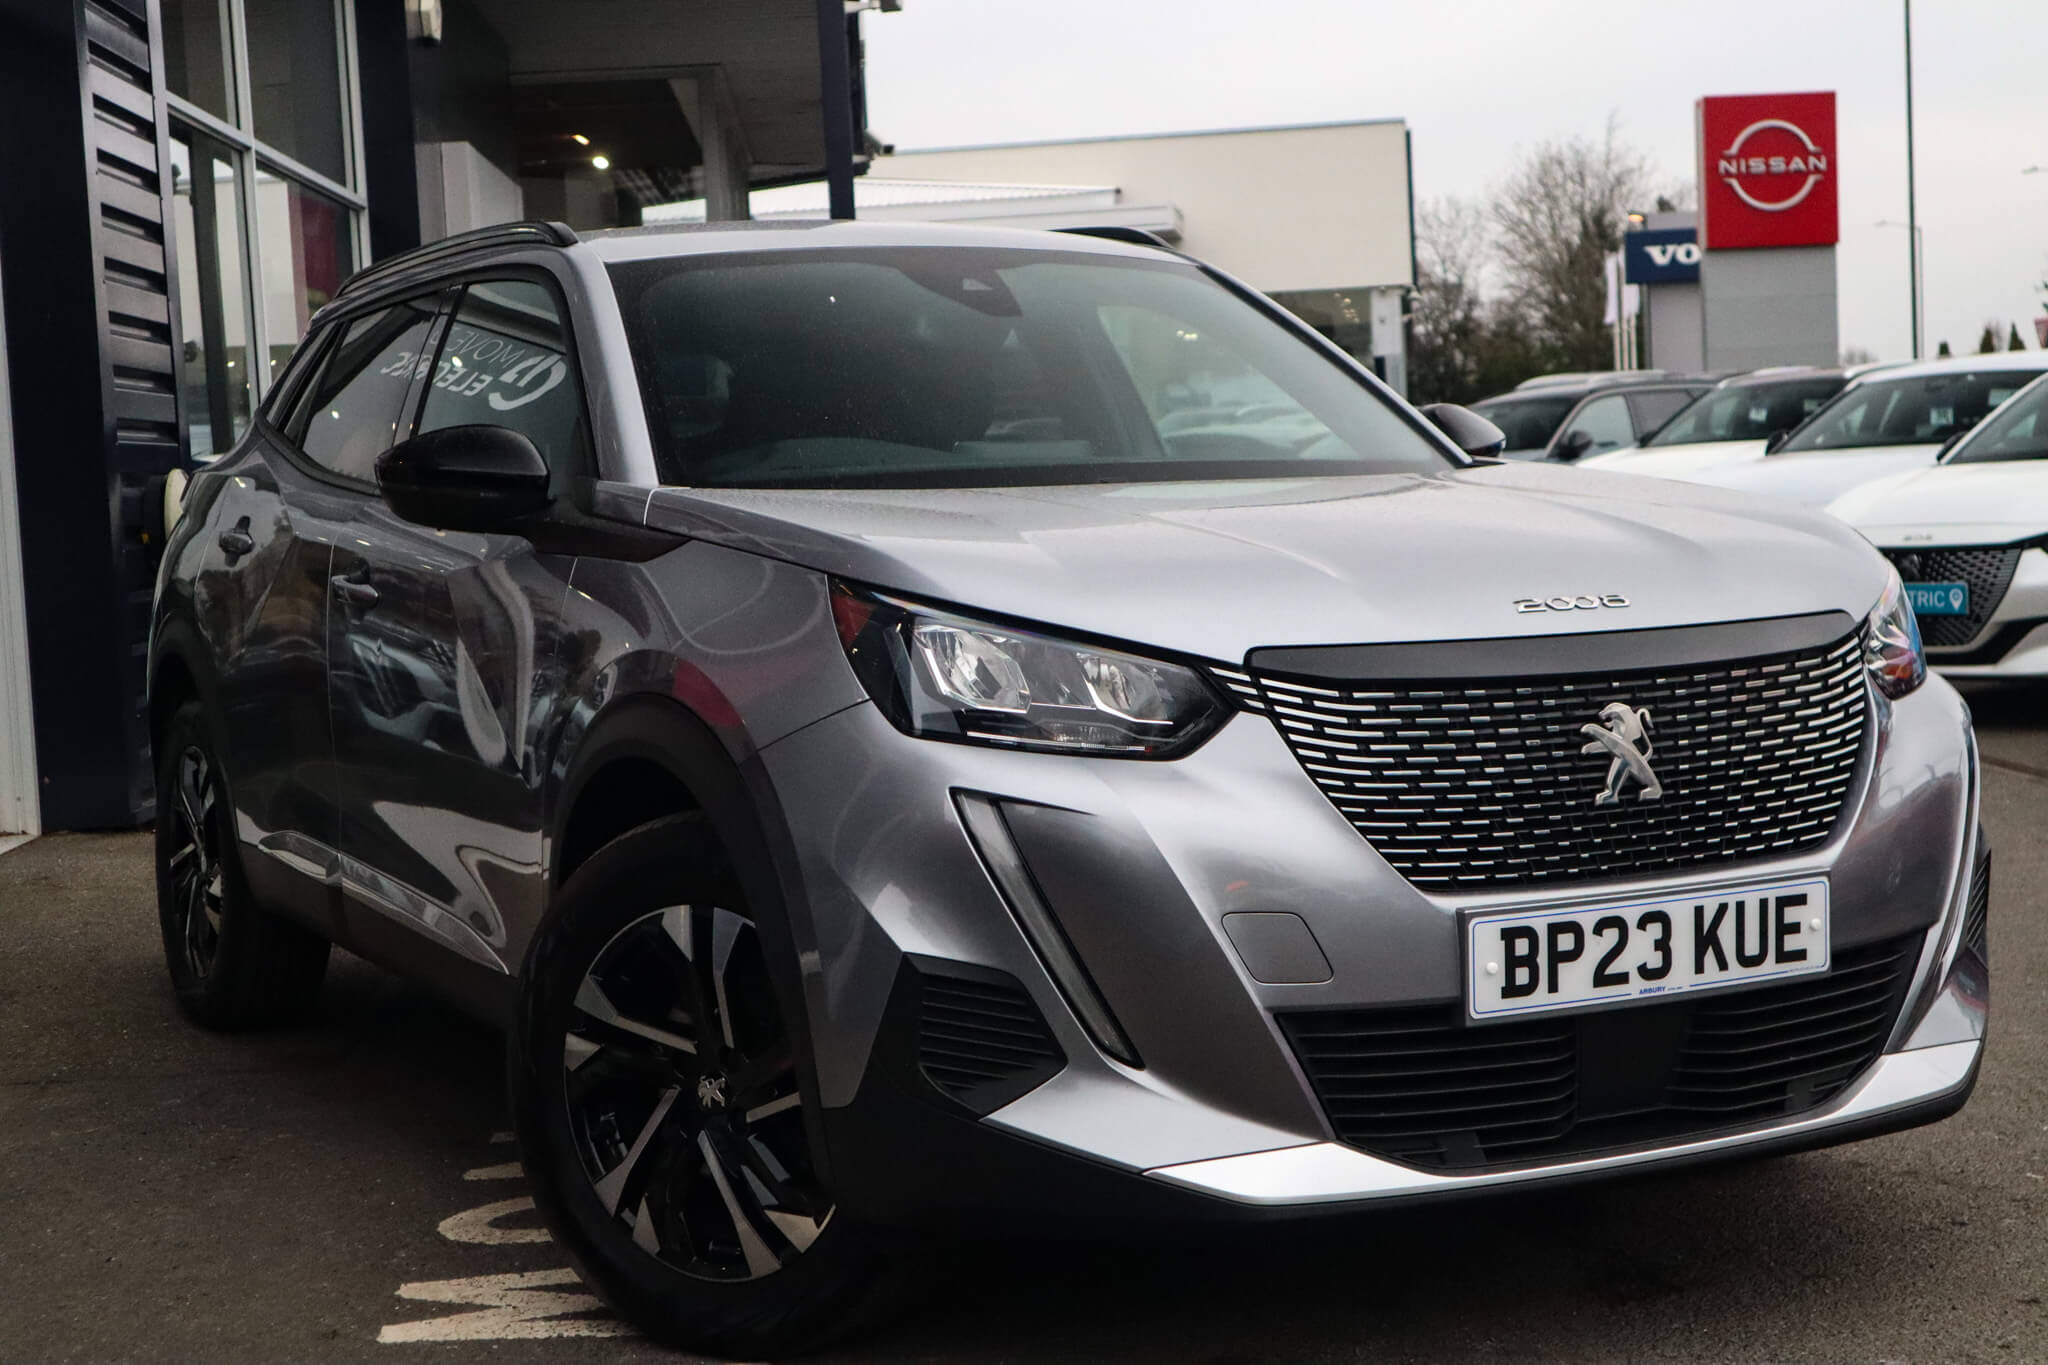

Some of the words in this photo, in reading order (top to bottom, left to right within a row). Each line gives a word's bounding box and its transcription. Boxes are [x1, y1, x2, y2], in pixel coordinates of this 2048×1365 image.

[1718, 154, 1827, 175] NISSAN
[1513, 594, 1631, 613] 2008
[1500, 909, 1673, 999] BP23
[1694, 893, 1808, 976] KUE
